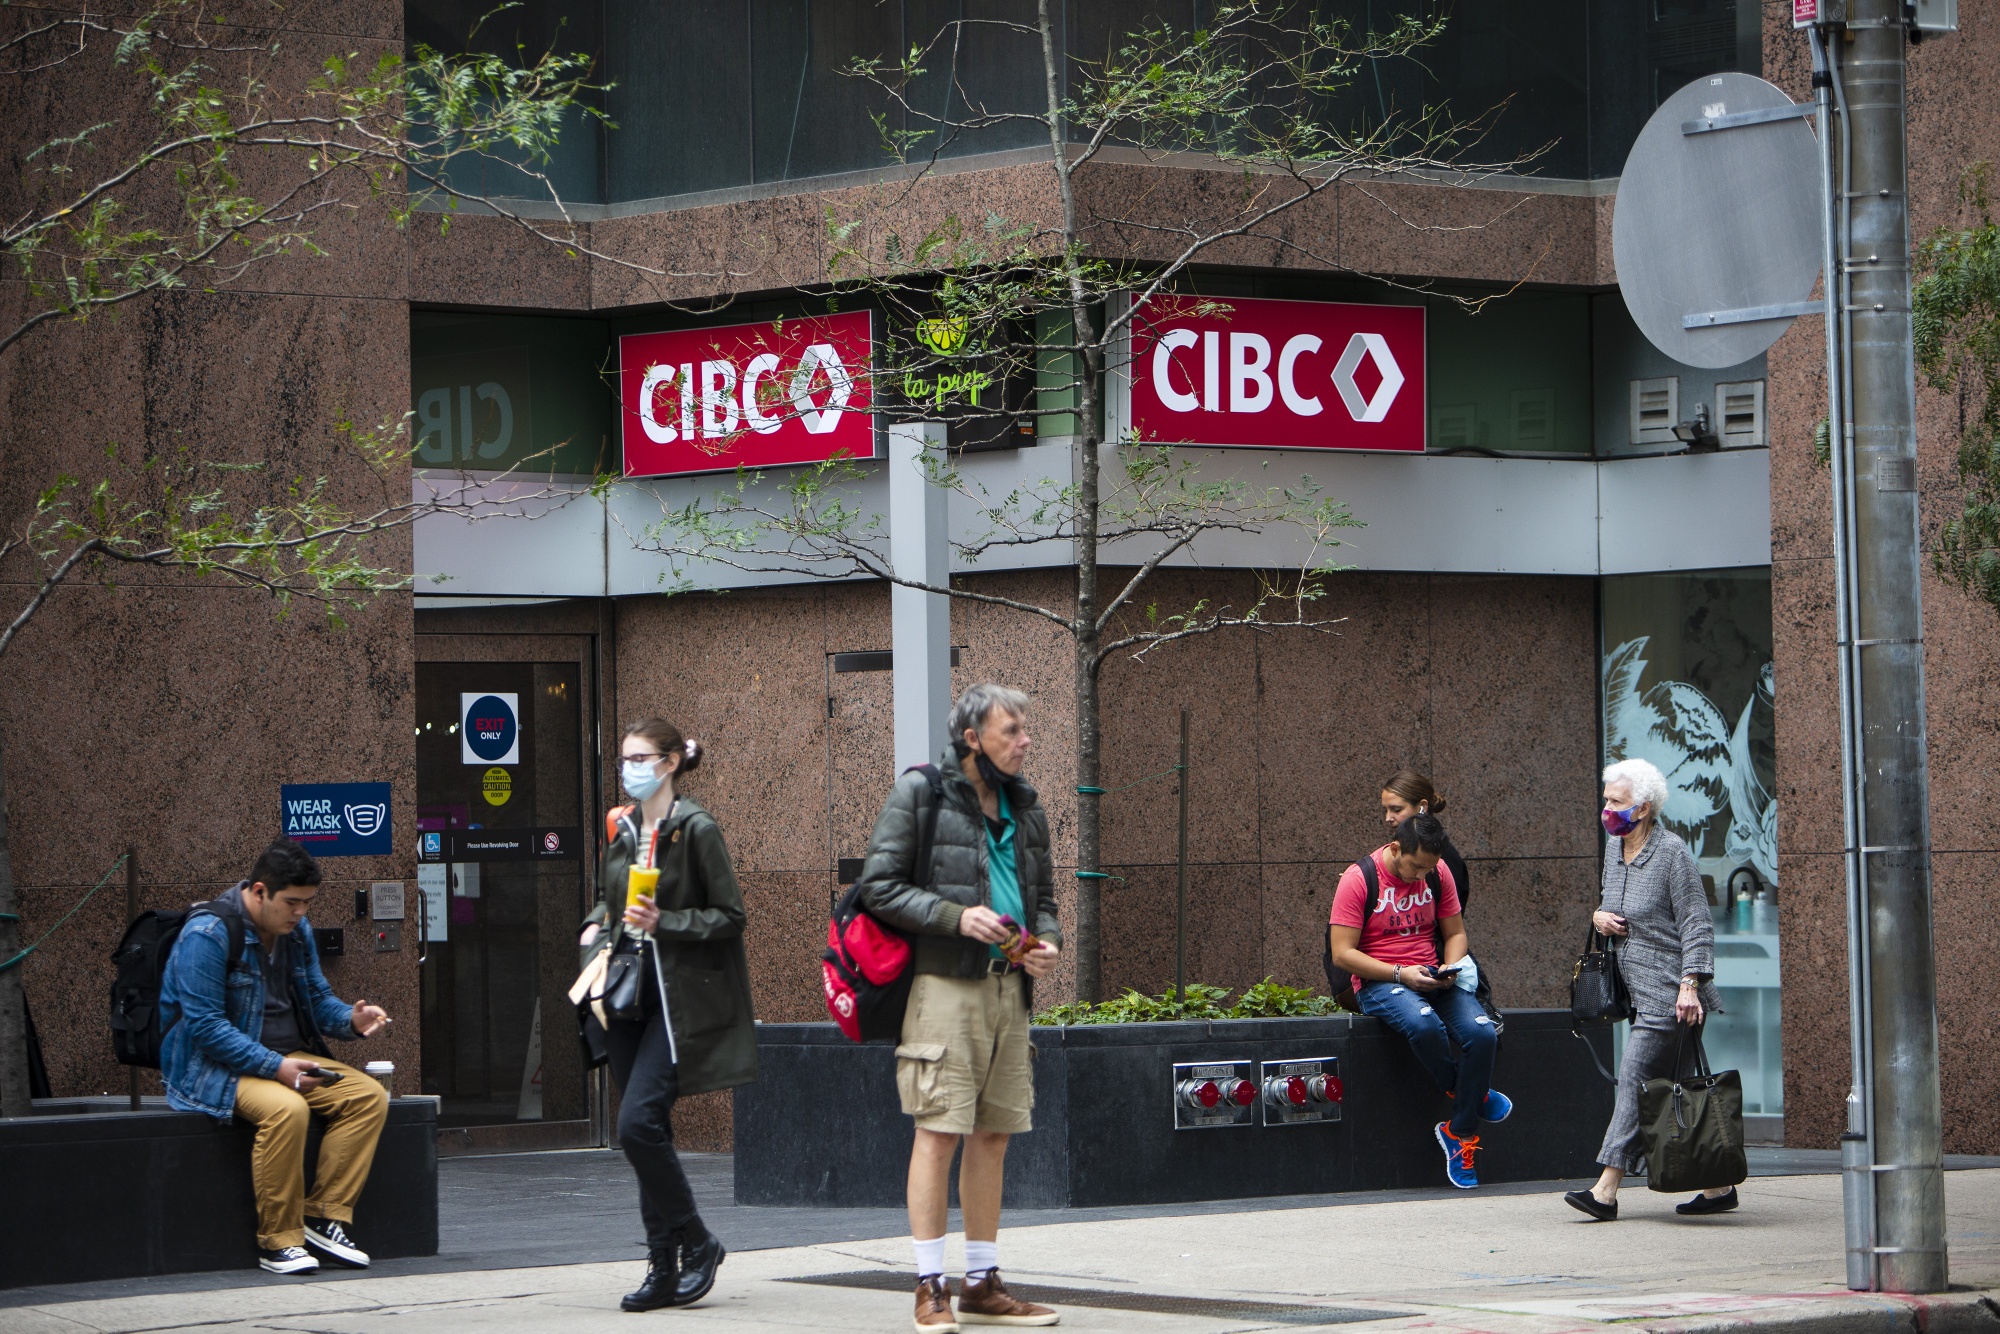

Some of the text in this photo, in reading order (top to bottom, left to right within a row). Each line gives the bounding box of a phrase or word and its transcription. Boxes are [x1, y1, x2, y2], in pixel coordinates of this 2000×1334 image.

[1153, 328, 1324, 416] CIBC
[639, 353, 783, 444] CIBC
[475, 718, 505, 731] EXIT
[480, 731, 501, 740] ONLY
[287, 799, 332, 815] WEAR
[288, 814, 342, 831] A MASK
[489, 841, 509, 849] Revolving
[376, 894, 401, 902] BUTTON
[1373, 887, 1432, 913] Aero
[1406, 912, 1425, 924] CAL
